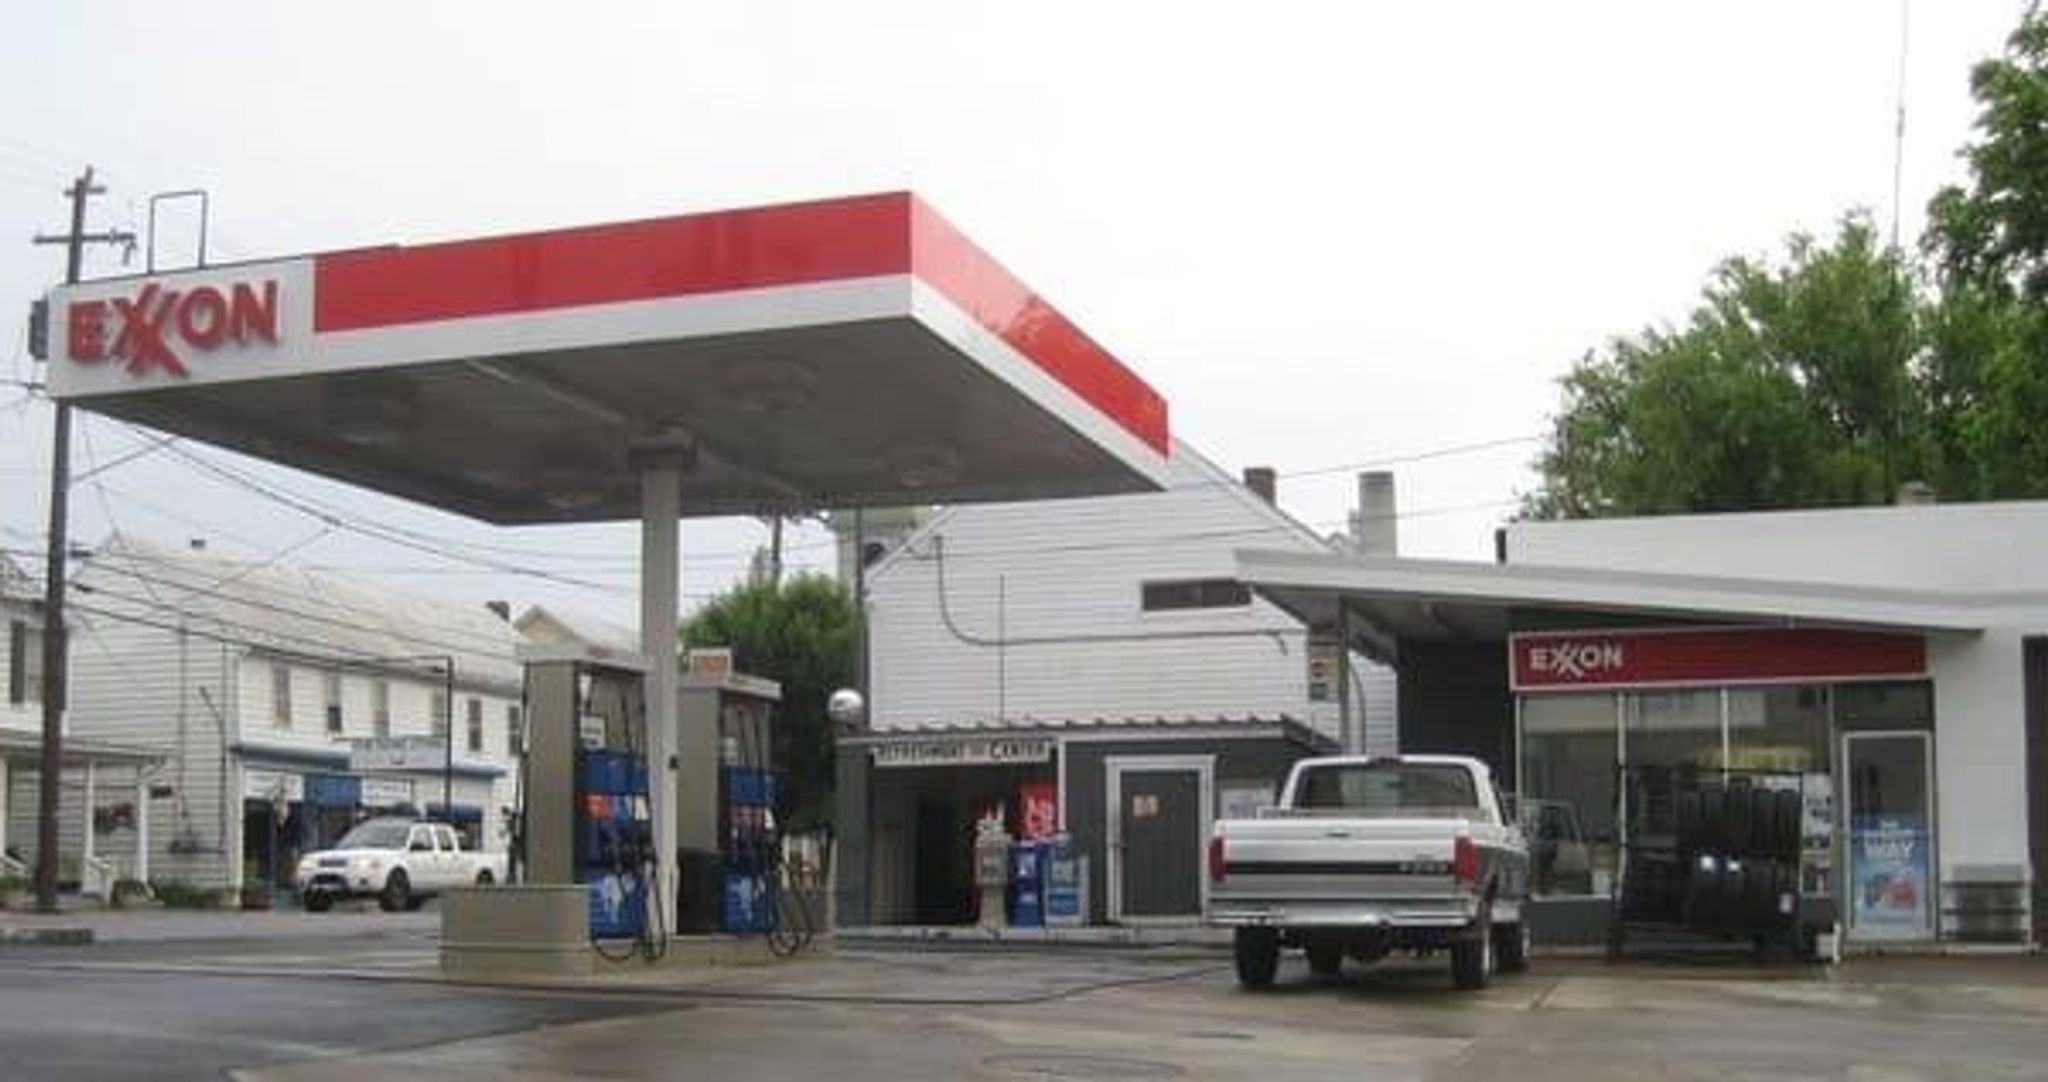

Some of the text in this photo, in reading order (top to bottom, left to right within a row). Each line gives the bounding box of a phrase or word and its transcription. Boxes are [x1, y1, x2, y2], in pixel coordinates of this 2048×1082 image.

[67, 280, 280, 377] EXXON
[1529, 642, 1623, 677] EXXON
[990, 739, 1047, 760] CENTER
